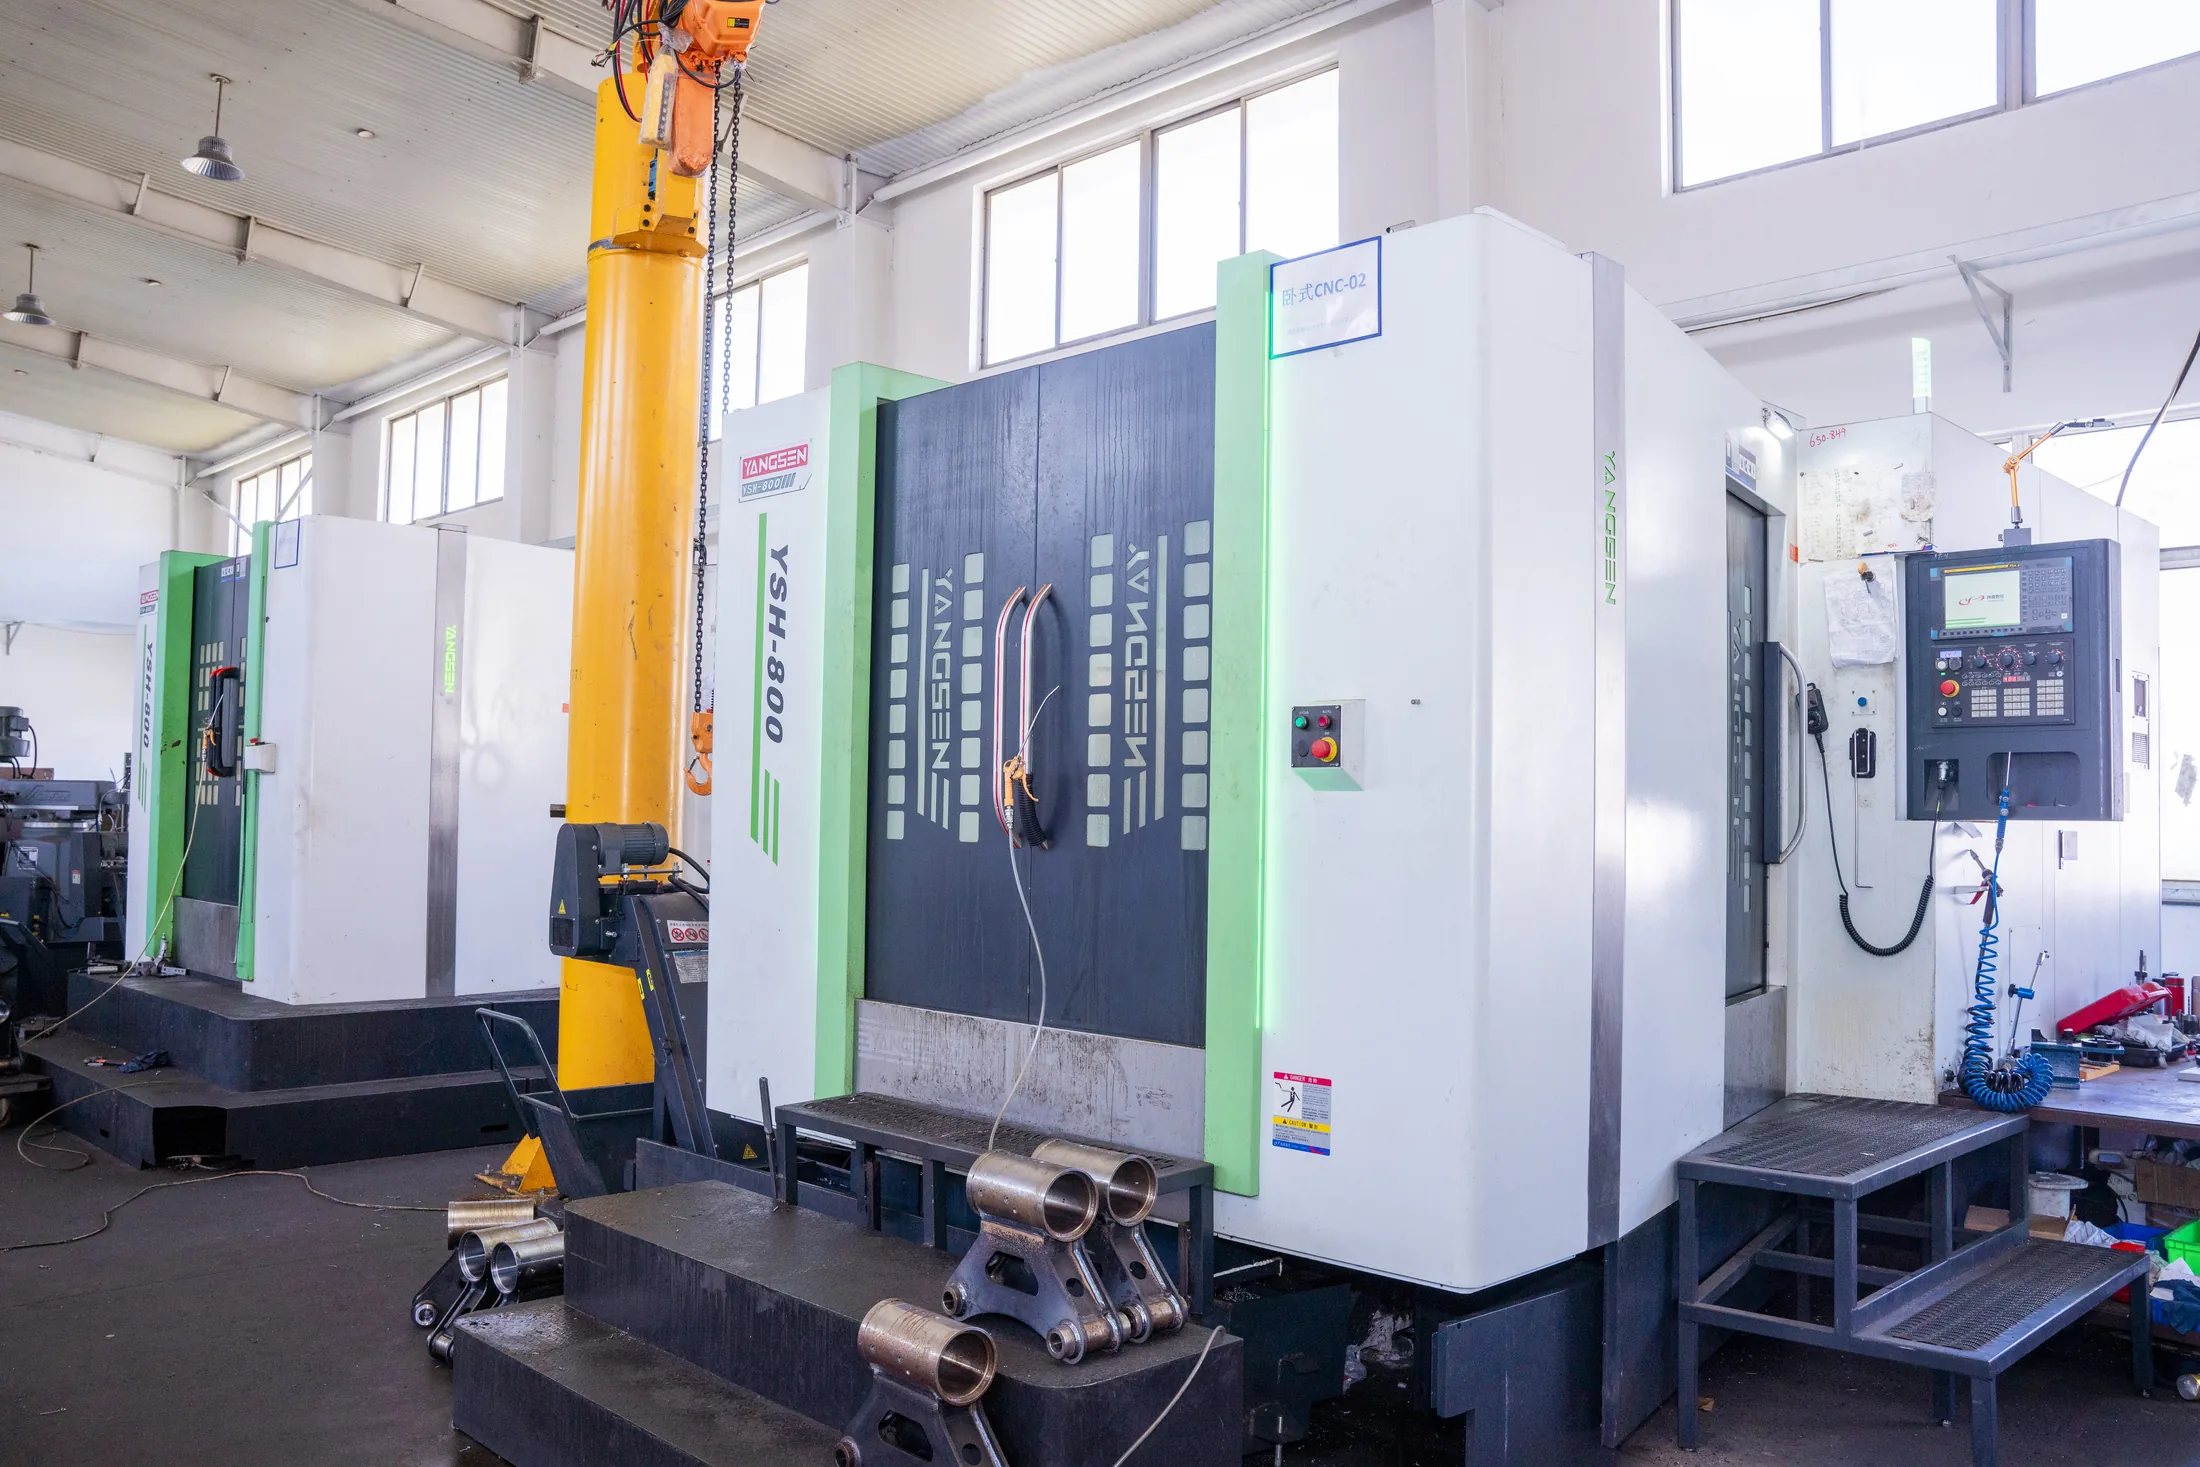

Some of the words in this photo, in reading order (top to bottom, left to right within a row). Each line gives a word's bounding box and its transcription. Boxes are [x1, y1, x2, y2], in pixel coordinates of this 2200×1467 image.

[1282, 272, 1367, 306] 卧式CNC-02
[742, 478, 781, 496] YSH-800
[744, 446, 807, 476] YANGSEN
[1604, 450, 1617, 605] YANGSEN
[444, 624, 457, 693] YANGSEN
[765, 544, 789, 744] YSH-800
[931, 568, 953, 769] YANGSEN
[143, 641, 153, 749] YSH-800
